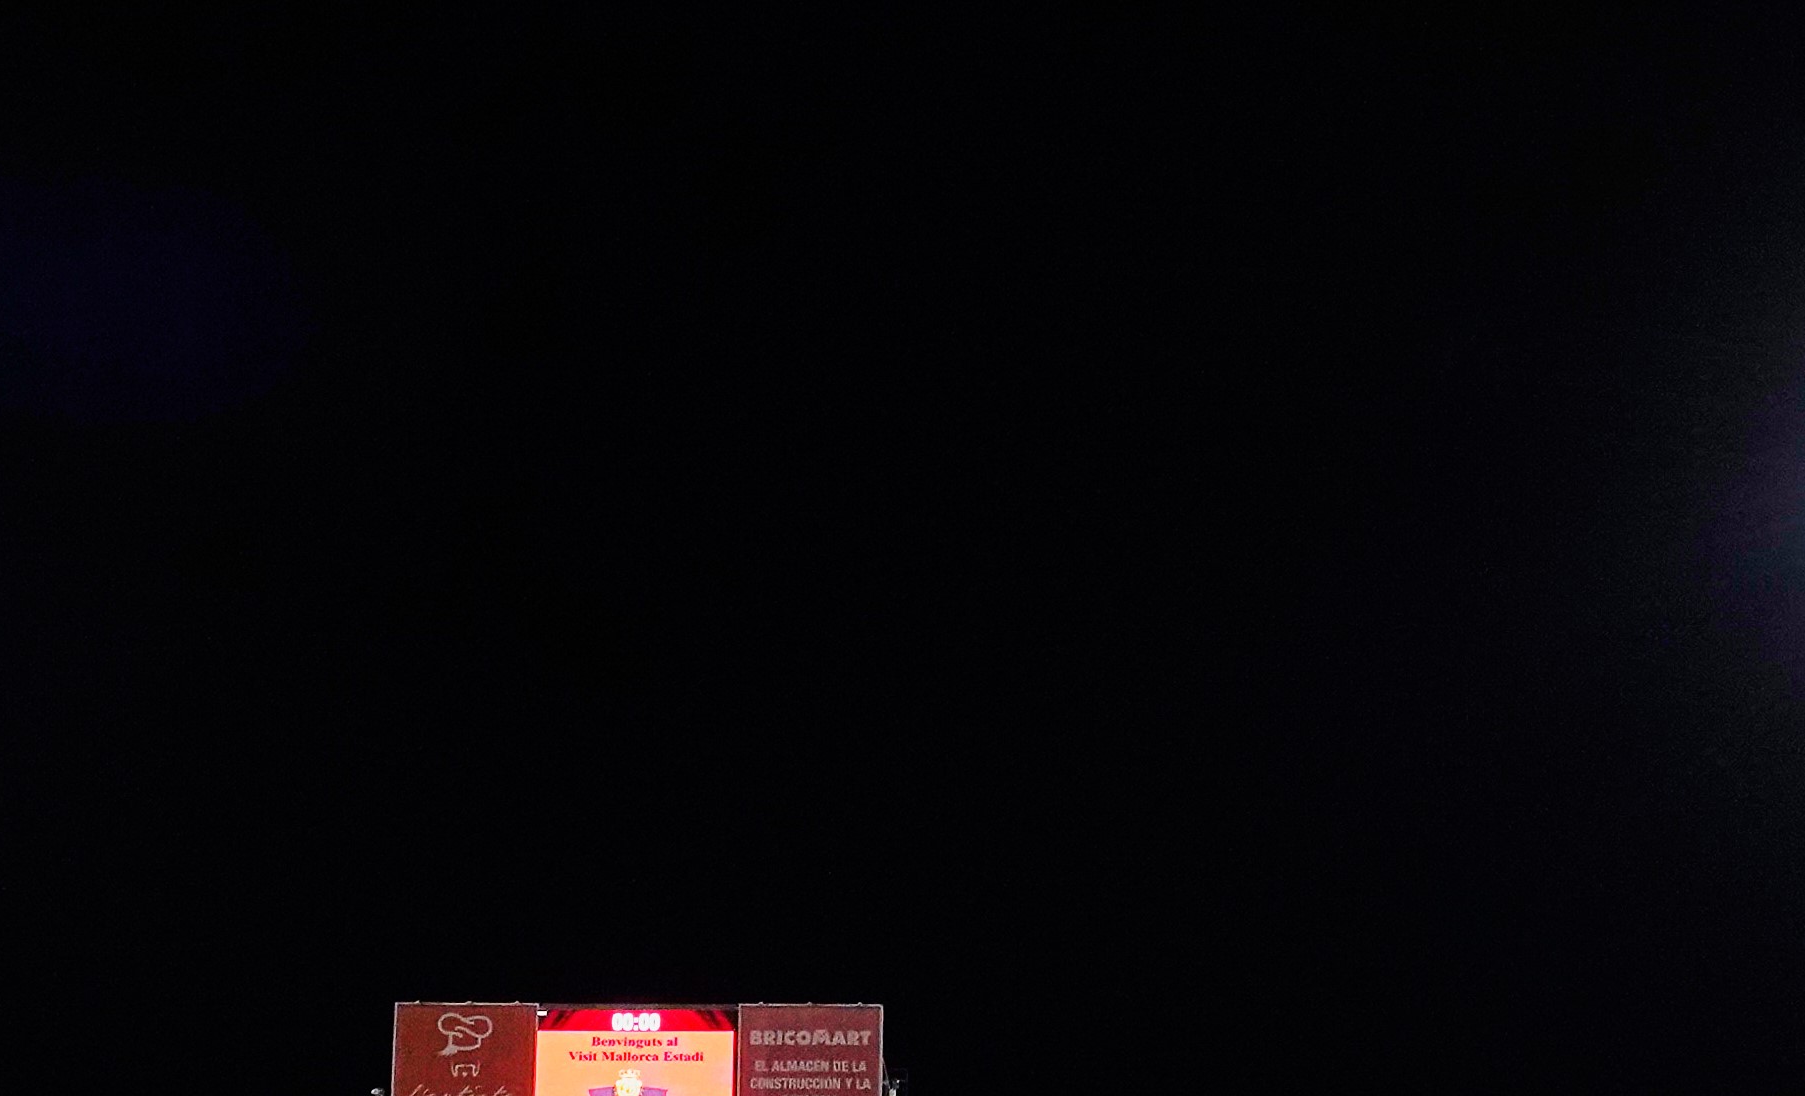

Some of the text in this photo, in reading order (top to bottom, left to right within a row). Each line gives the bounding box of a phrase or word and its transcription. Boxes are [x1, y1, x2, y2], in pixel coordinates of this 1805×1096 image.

[611, 1012, 661, 1032] 00:00
[591, 1036, 678, 1047] Benvinguts al
[749, 1029, 872, 1046] BRICOMART
[568, 1051, 704, 1062] Visit Mallorca Estadi
[754, 1060, 767, 1072] EL
[833, 1061, 849, 1072] DE
[852, 1061, 867, 1072] LA
[846, 1078, 853, 1090] Y
[856, 1078, 872, 1090] LA
